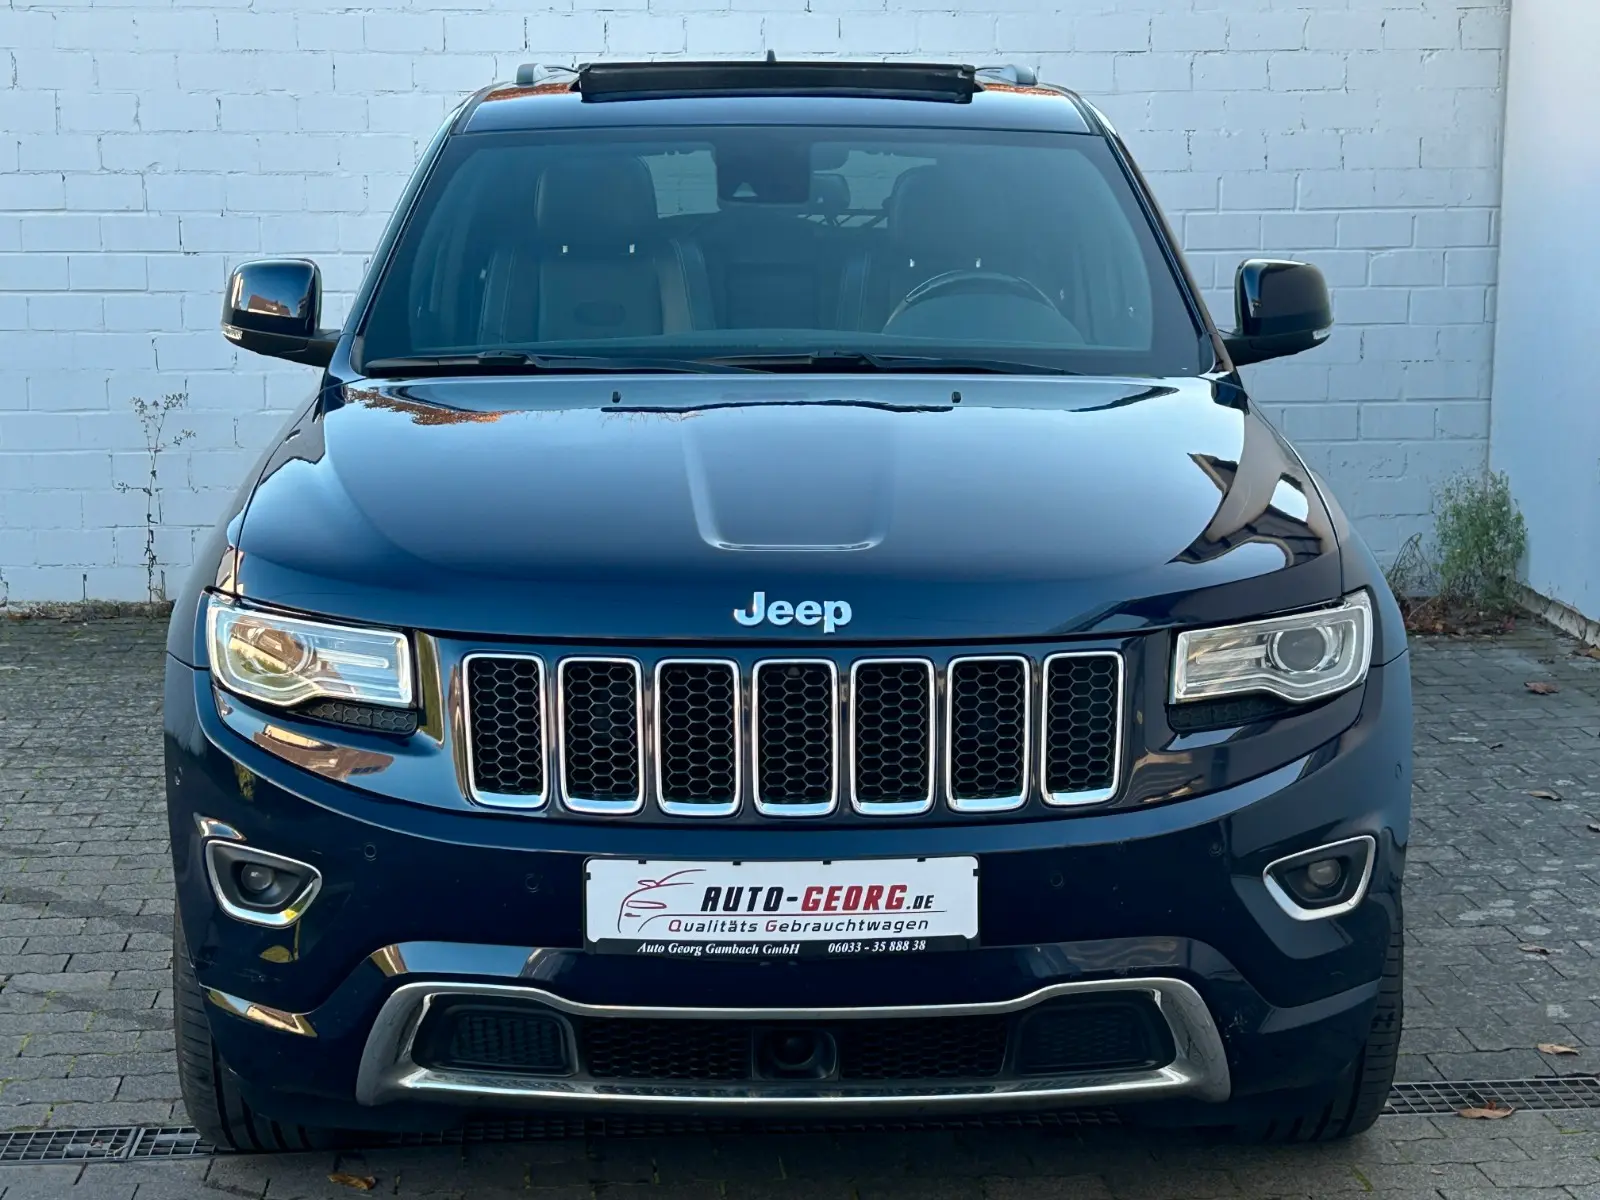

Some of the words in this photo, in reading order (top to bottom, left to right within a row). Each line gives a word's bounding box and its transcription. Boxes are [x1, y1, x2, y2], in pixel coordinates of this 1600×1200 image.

[733, 591, 852, 633] Jeep
[668, 919, 757, 933] Qualitäts
[765, 918, 929, 933] Gebrauchtwagen
[637, 942, 665, 955] Auto
[667, 942, 702, 956] Georg
[705, 942, 759, 955] Gambach
[762, 942, 800, 955] GmbH
[828, 941, 863, 953] 06033
[872, 941, 887, 953] 35
[889, 940, 909, 953] 888
[911, 940, 926, 952] 38
